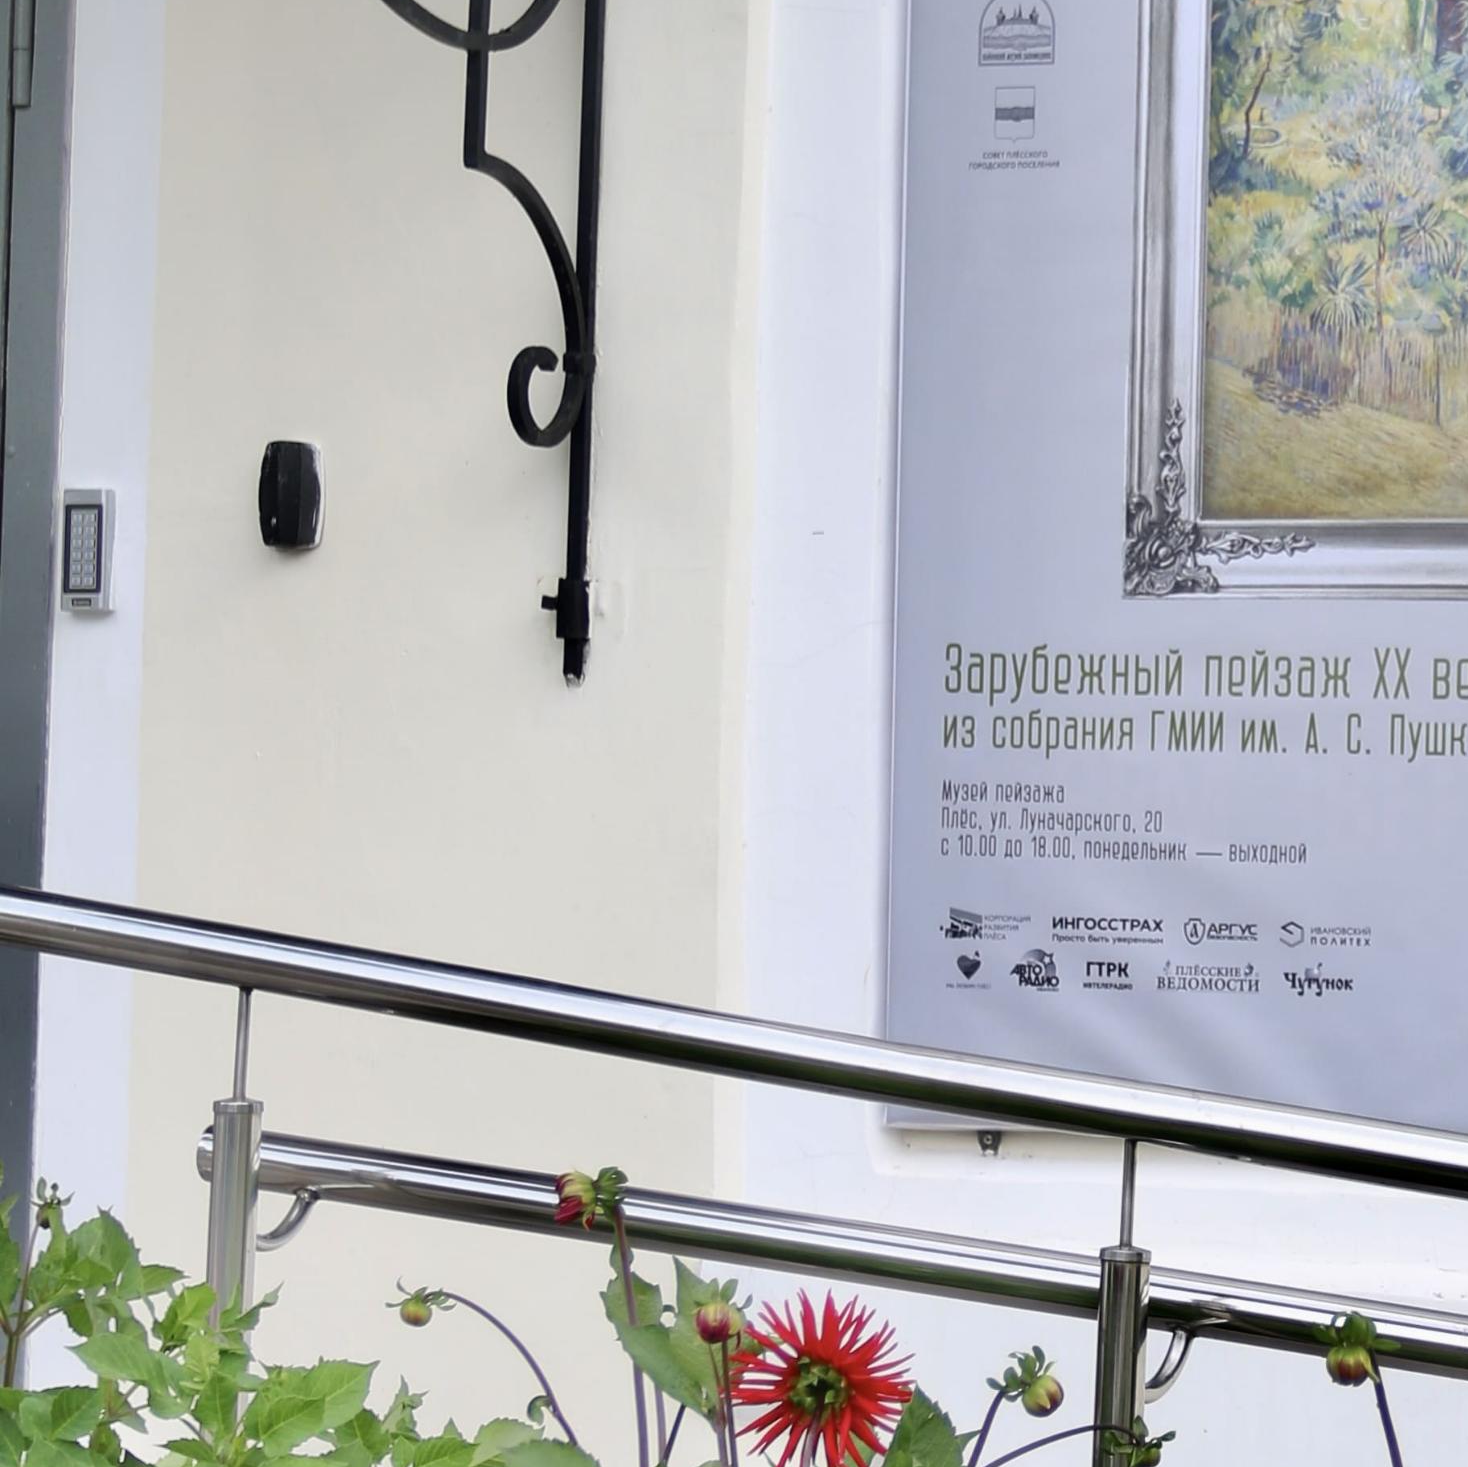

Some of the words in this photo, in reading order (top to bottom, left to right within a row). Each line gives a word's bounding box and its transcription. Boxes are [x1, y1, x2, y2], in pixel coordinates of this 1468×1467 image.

[944, 643, 1183, 706] Зарубежный
[1204, 650, 1351, 698] пейзаж
[1373, 647, 1411, 699] XX
[943, 715, 975, 749] из
[992, 709, 1133, 759] собрания
[1150, 710, 1223, 752] ГМИИ
[1241, 719, 1287, 753] им.
[1305, 712, 1328, 754] А.
[1346, 713, 1371, 755] С.
[942, 780, 988, 805] Музей
[995, 782, 1065, 803] пейзажа
[941, 806, 982, 831] Плёс,
[990, 811, 1012, 833] ул.
[1020, 808, 1136, 836] Луначарского,
[1144, 810, 1163, 833] 20
[940, 838, 949, 856] с
[957, 834, 998, 857] 10.00
[1004, 839, 1022, 859] до
[1031, 836, 1076, 860] 18.00,
[1084, 840, 1187, 862] понедельник
[1229, 843, 1307, 865] выходной
[1052, 916, 1164, 932] ИНГОССТРАХ
[1206, 923, 1258, 936] АРГУС
[1052, 933, 1086, 944] Просто
[1088, 934, 1110, 944] быть
[1112, 936, 1164, 945] уверенным
[1310, 936, 1371, 947] ПОЛИТЕХ
[1010, 962, 1043, 976] АВТО
[1086, 961, 1129, 978] ГТРК
[1175, 963, 1241, 977] ПЛЁССКИЕ
[1018, 975, 1060, 988] РАДИО
[1156, 975, 1260, 992] ВЕДОМОСТИ
